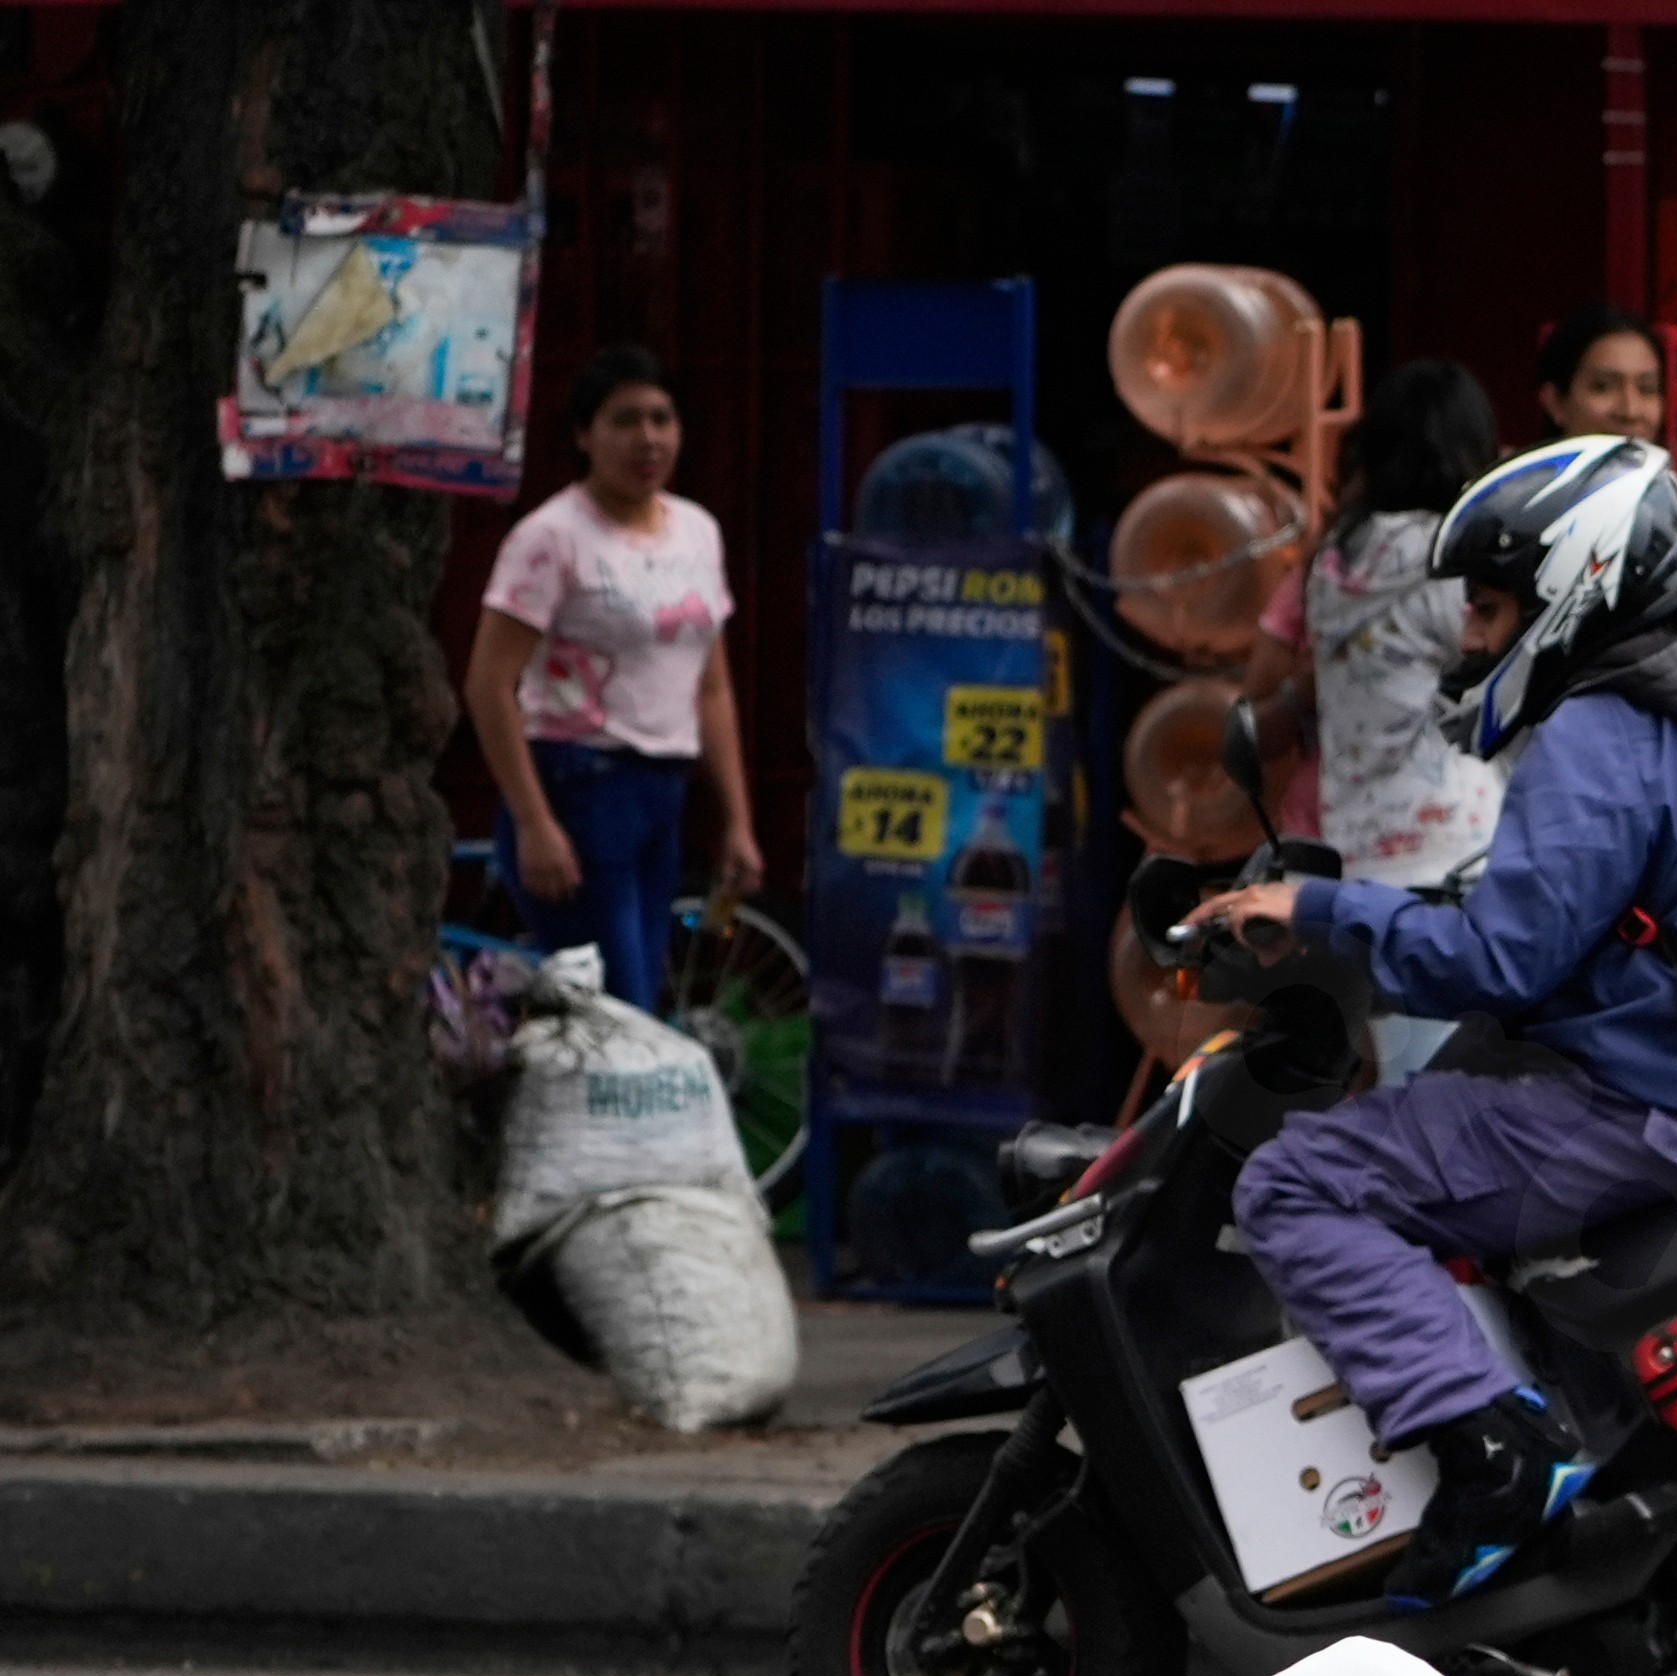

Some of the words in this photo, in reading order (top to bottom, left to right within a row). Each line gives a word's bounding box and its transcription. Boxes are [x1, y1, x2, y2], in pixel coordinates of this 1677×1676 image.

[851, 562, 959, 602] PEPSI
[849, 603, 901, 632] LOS
[905, 603, 1042, 641] PRECIOS
